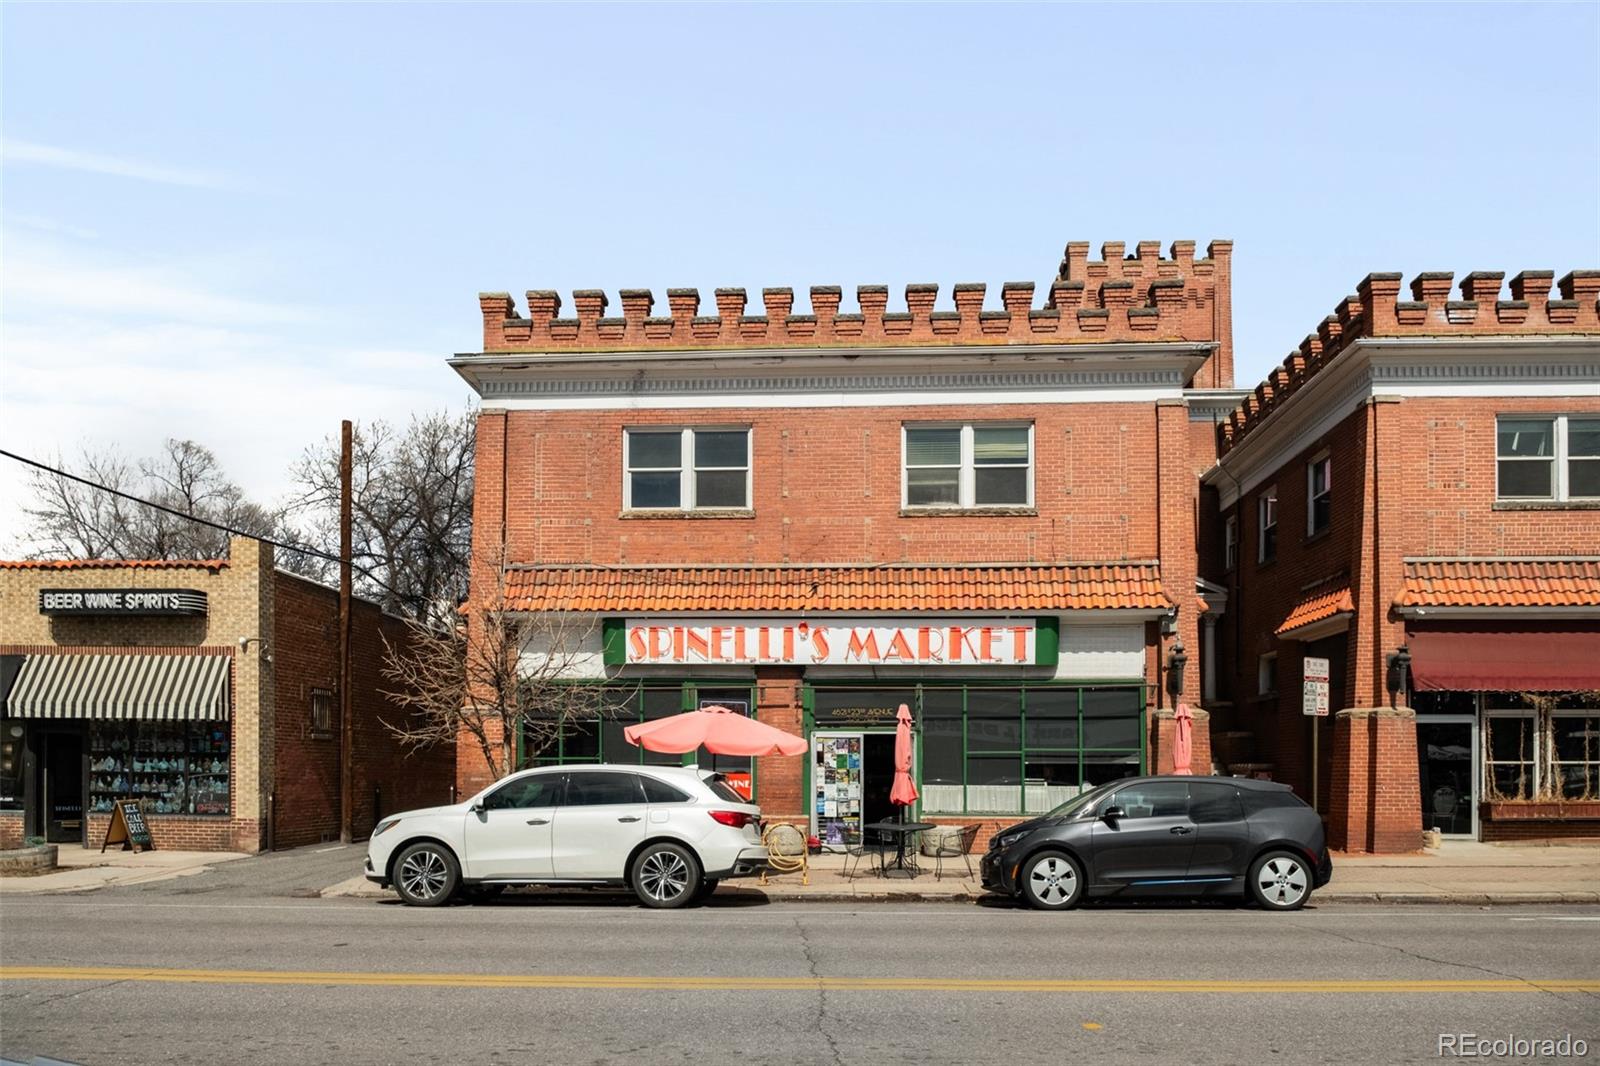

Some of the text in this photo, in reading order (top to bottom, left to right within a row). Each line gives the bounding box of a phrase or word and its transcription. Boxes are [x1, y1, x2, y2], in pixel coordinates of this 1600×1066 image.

[43, 593, 180, 609] BEER WINE SPIRITS
[628, 621, 1034, 664] SPINELLI'S MARKET
[123, 804, 139, 813] ICE
[128, 823, 146, 834] BEER
